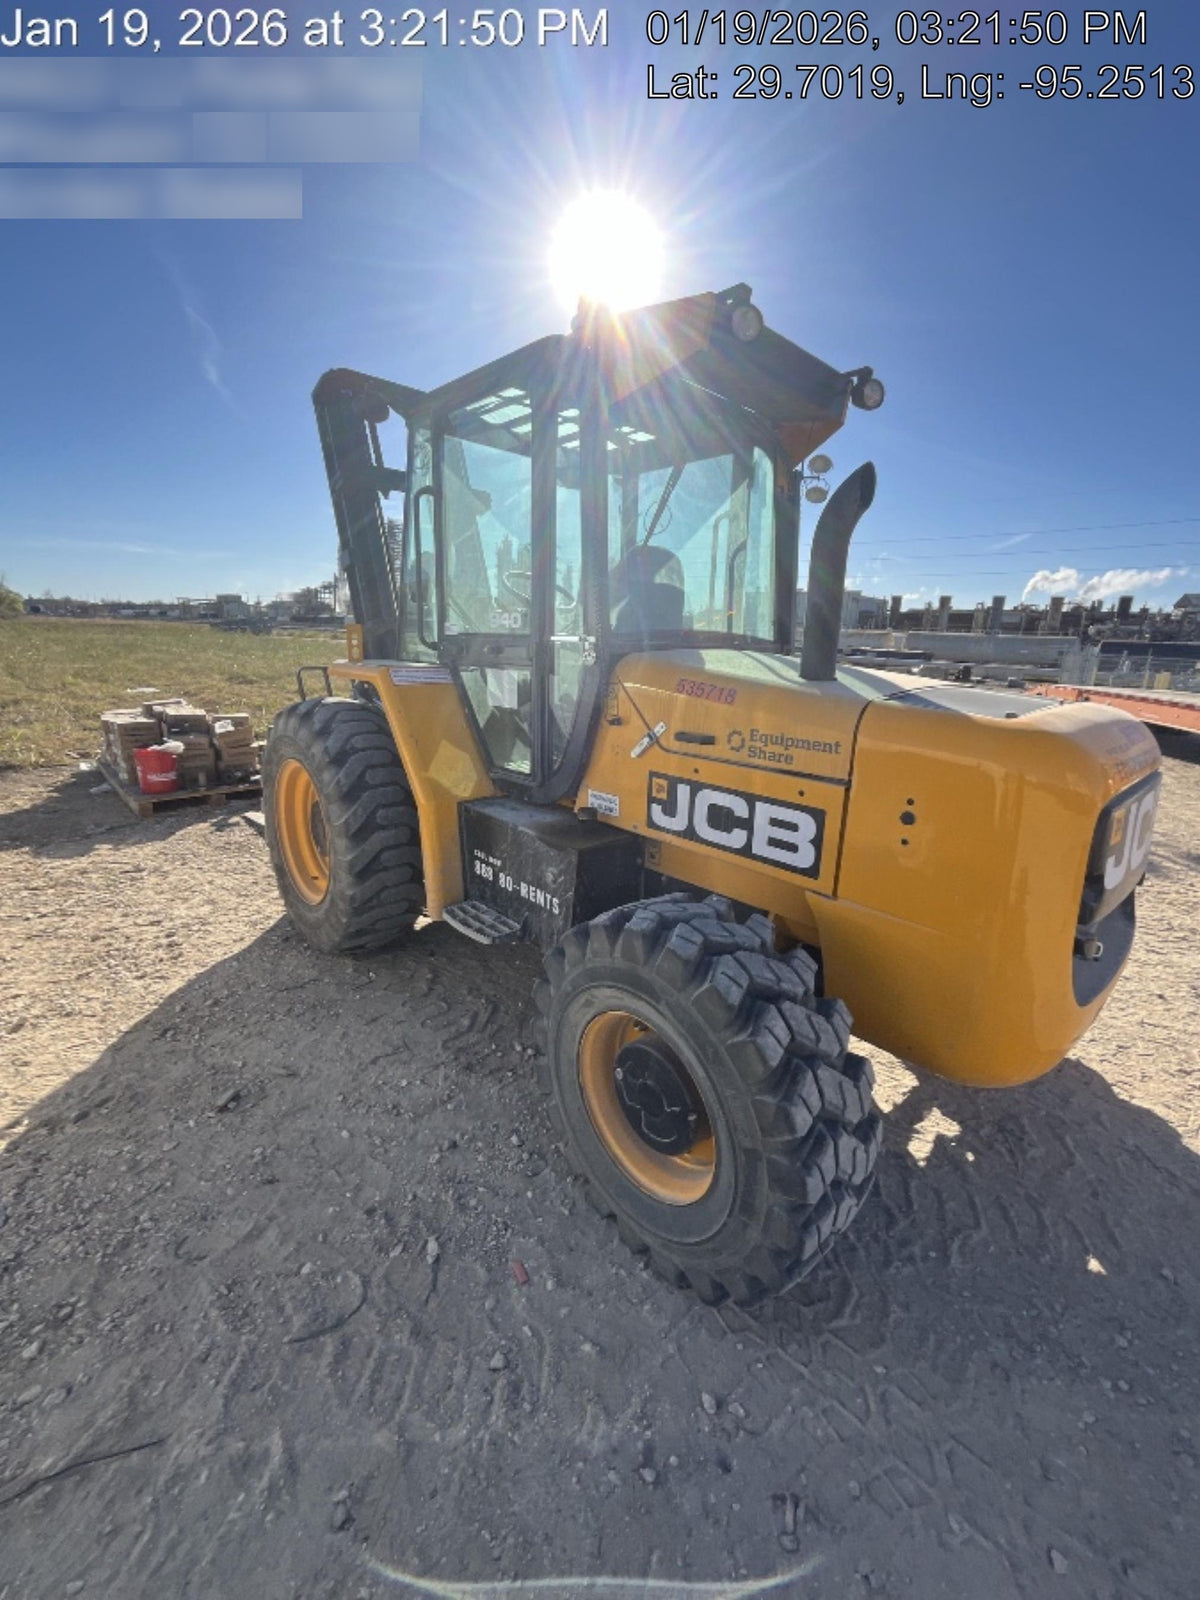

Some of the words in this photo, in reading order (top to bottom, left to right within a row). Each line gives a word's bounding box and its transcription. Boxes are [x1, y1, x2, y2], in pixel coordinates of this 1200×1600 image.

[676, 678, 738, 705] 535718
[749, 728, 842, 754] Equipment
[747, 745, 794, 765] Share
[650, 783, 817, 869] JCB
[1103, 789, 1156, 890] JC
